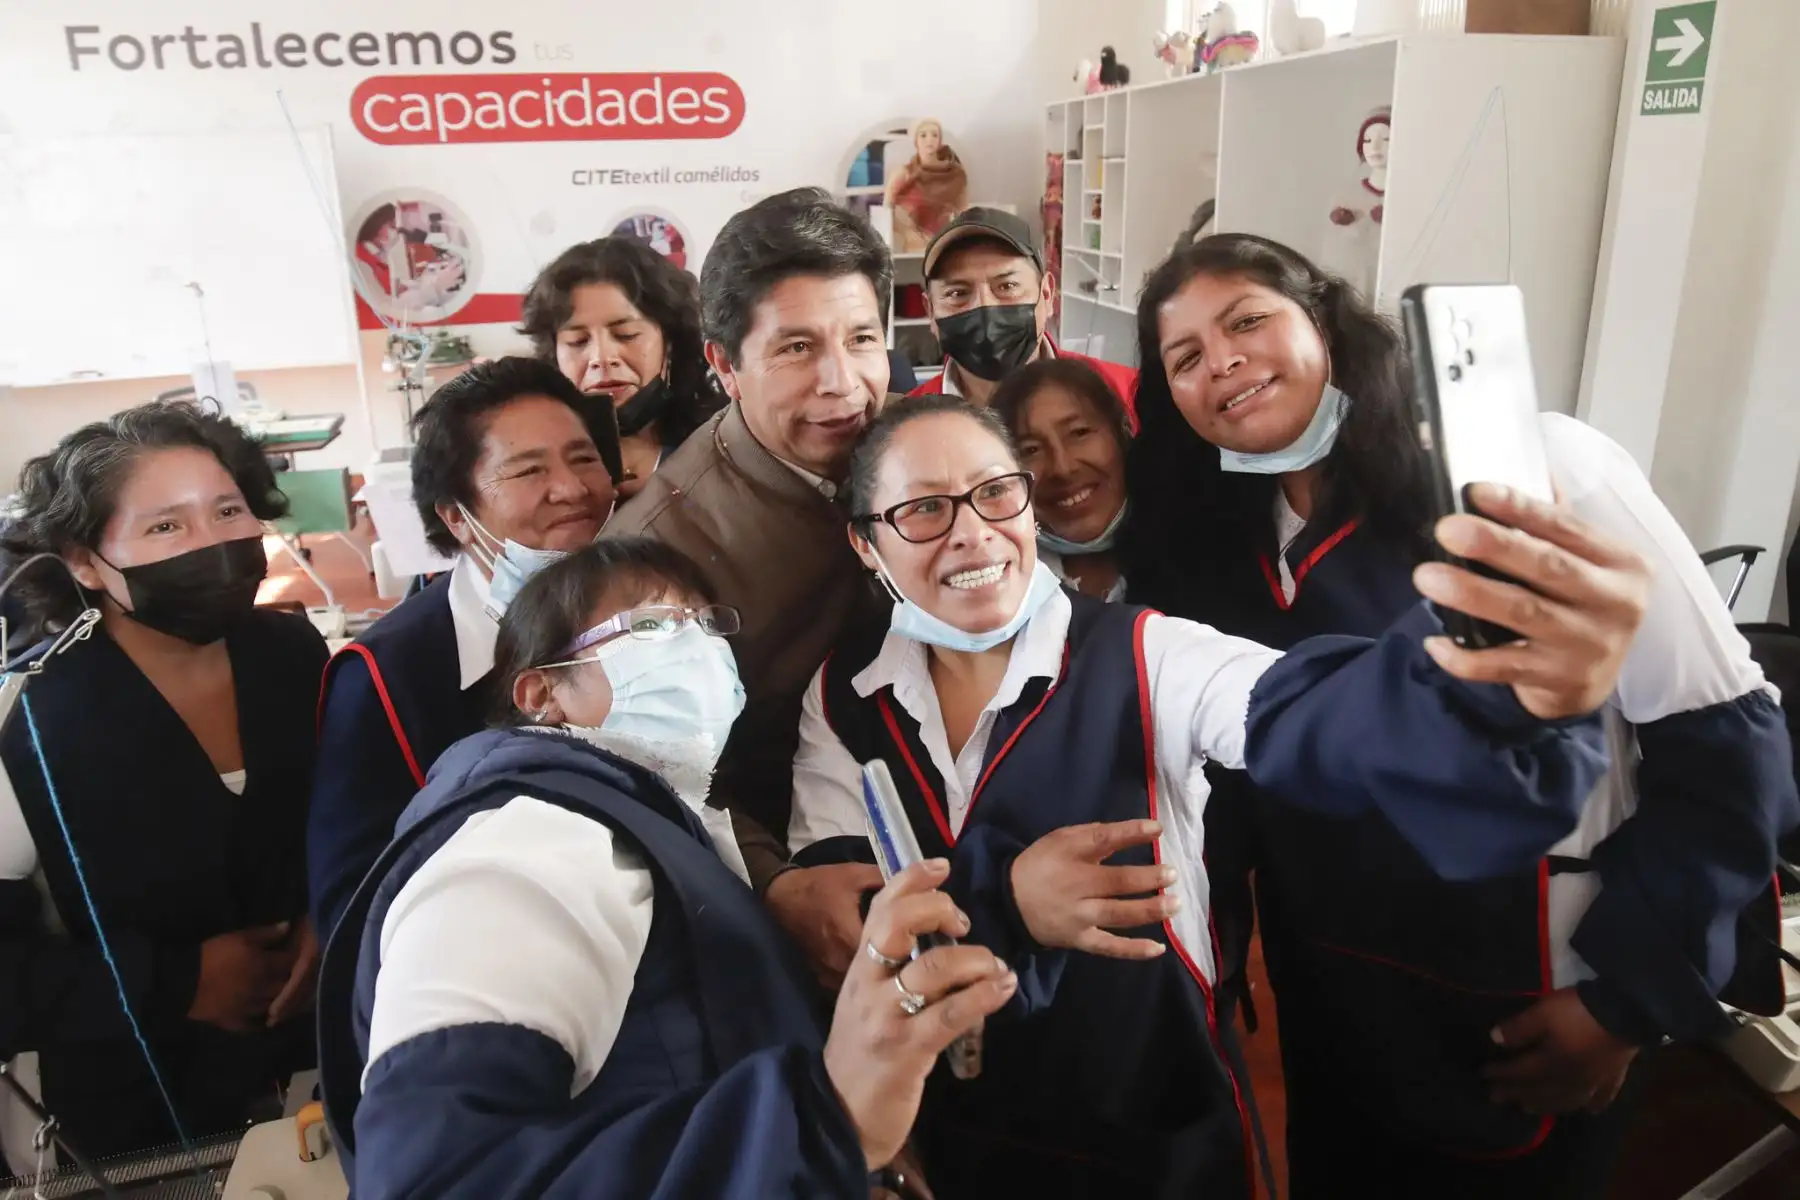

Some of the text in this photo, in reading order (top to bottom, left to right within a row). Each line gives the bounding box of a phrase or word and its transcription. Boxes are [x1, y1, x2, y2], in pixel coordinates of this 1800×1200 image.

[64, 22, 576, 71] Fortalecemos tus
[362, 76, 732, 142] capacidades
[1643, 87, 1698, 110] SALIDA
[571, 164, 761, 186] CITEtextil camélidos
